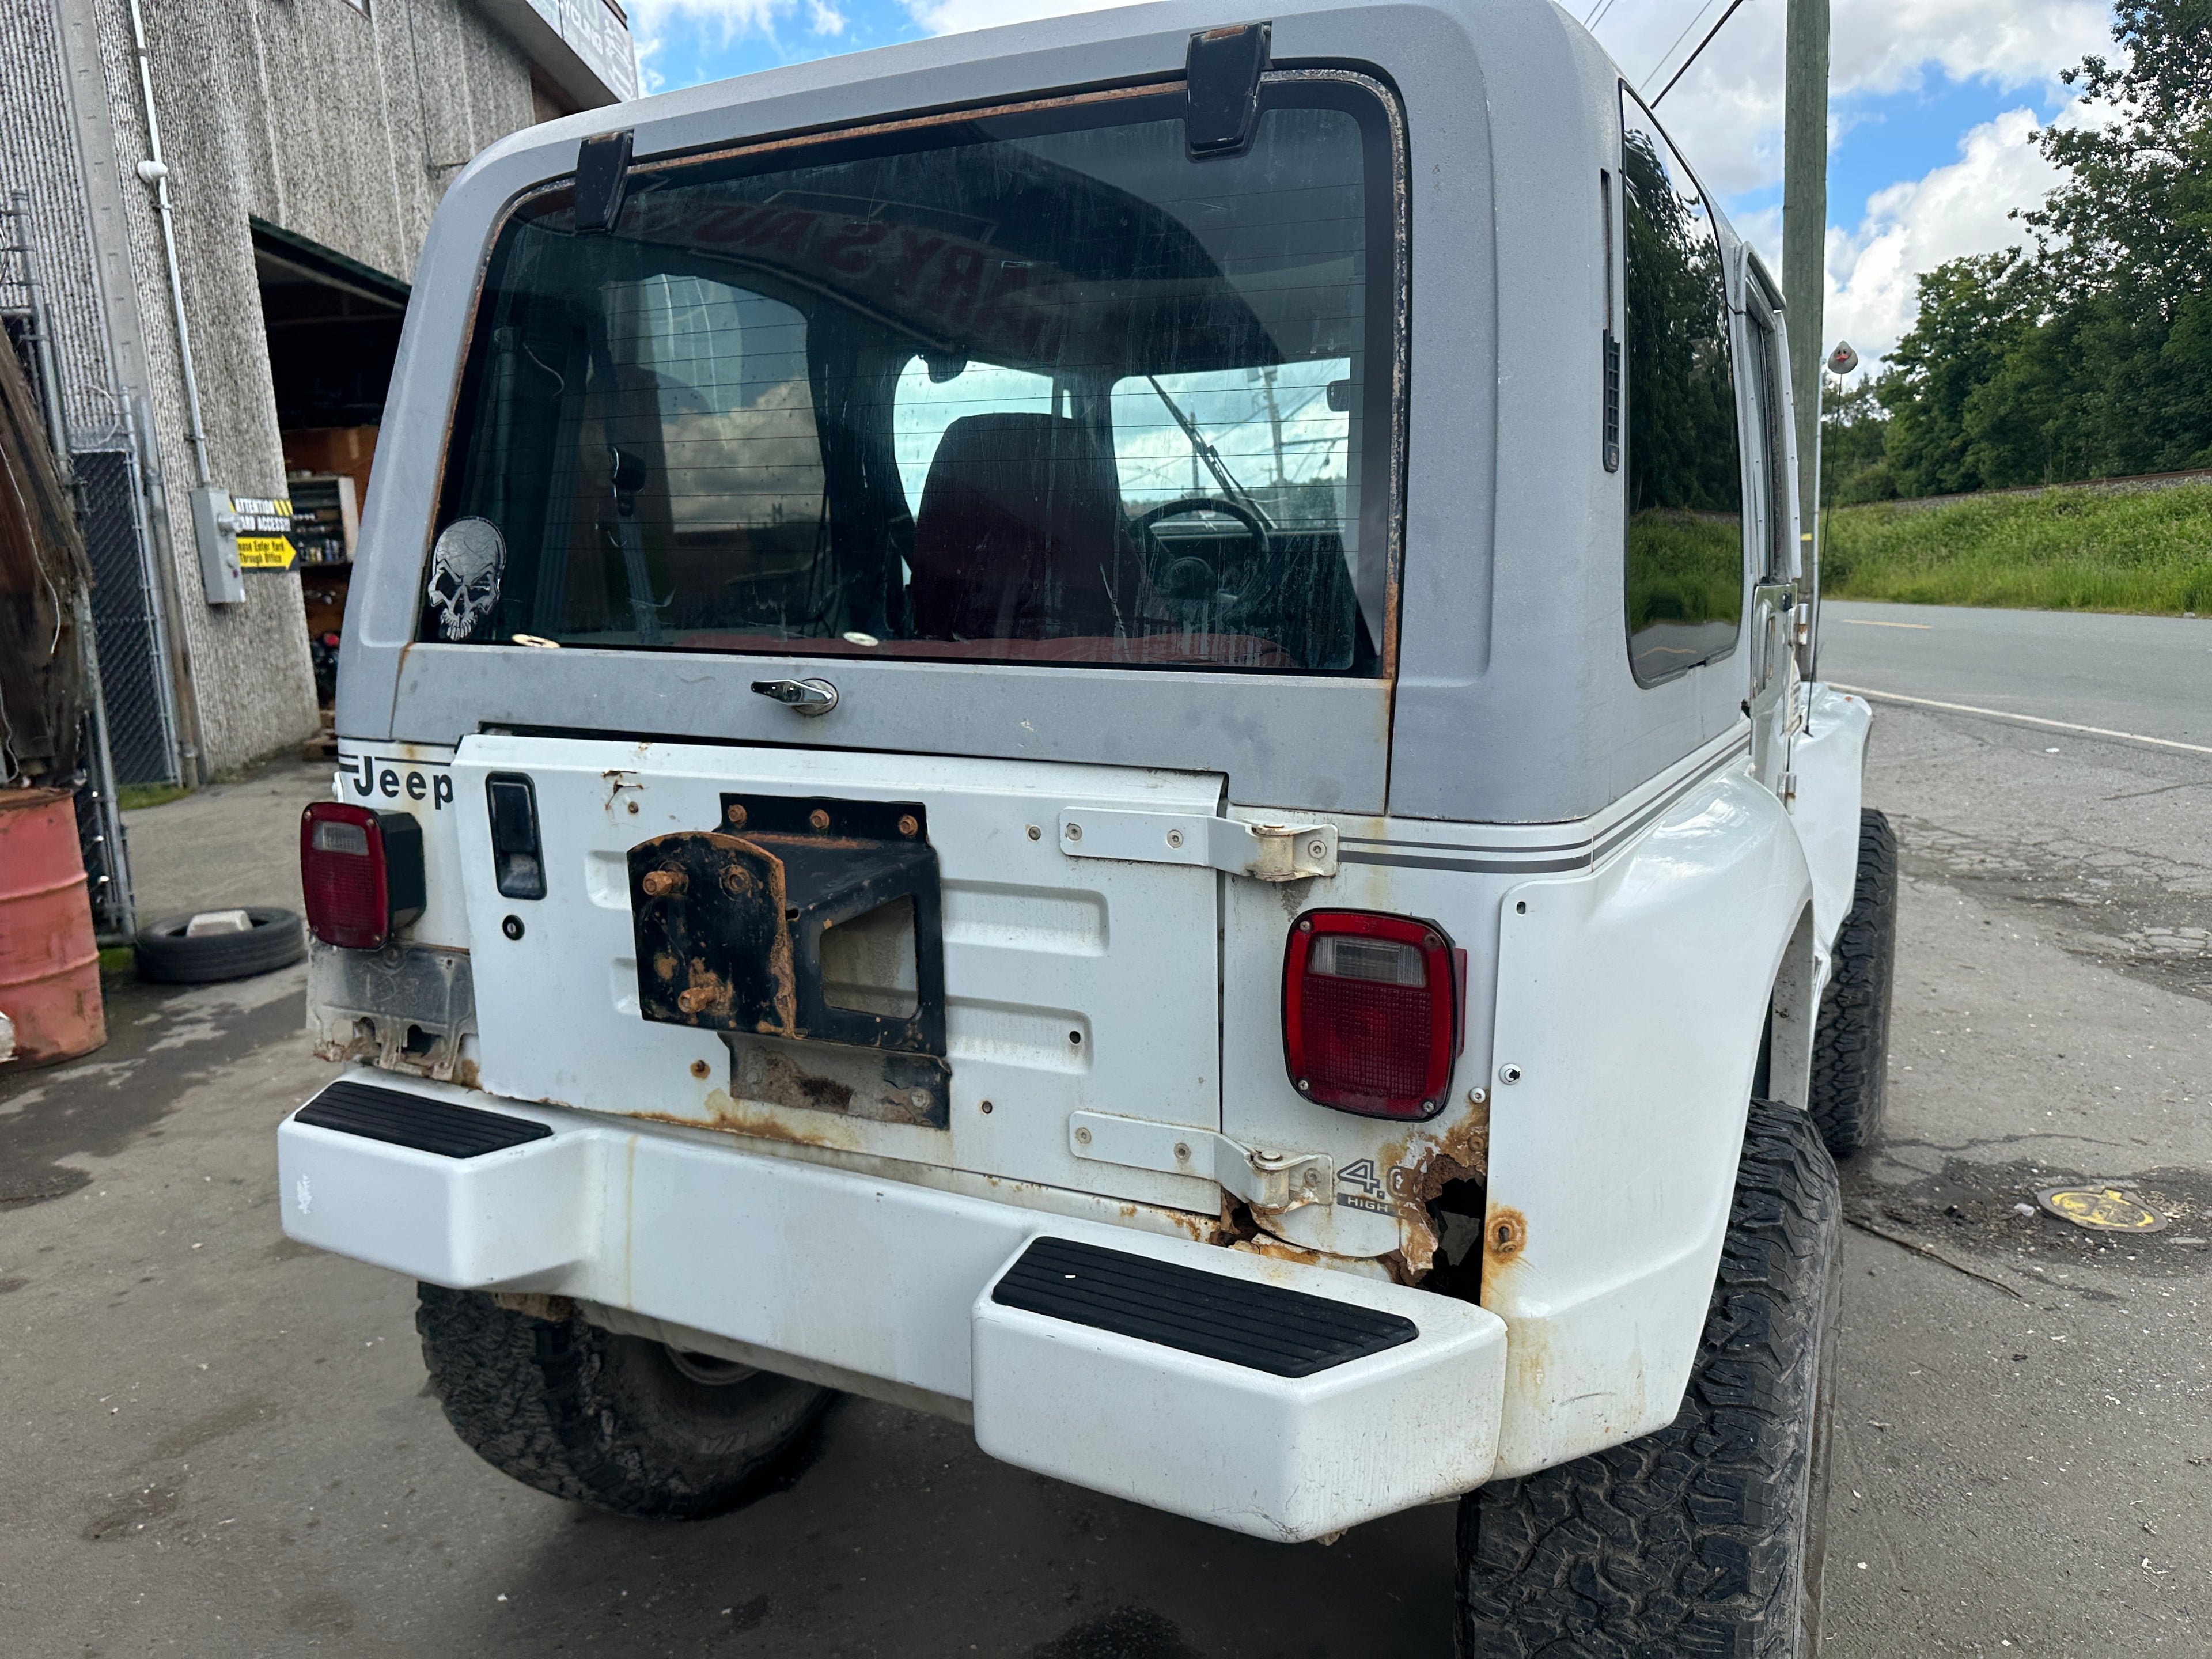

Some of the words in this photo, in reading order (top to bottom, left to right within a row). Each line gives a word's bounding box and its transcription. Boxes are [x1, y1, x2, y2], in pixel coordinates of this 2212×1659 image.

[235, 498, 275, 513] ATTENTION
[240, 514, 255, 531] ARD
[238, 541, 252, 551] ease
[254, 541, 270, 551] Enter
[272, 541, 284, 551] Yard
[239, 553, 263, 564] Through
[265, 553, 282, 563] Office
[353, 756, 454, 810] Jeep
[1347, 1196, 1388, 1213] HIGH
